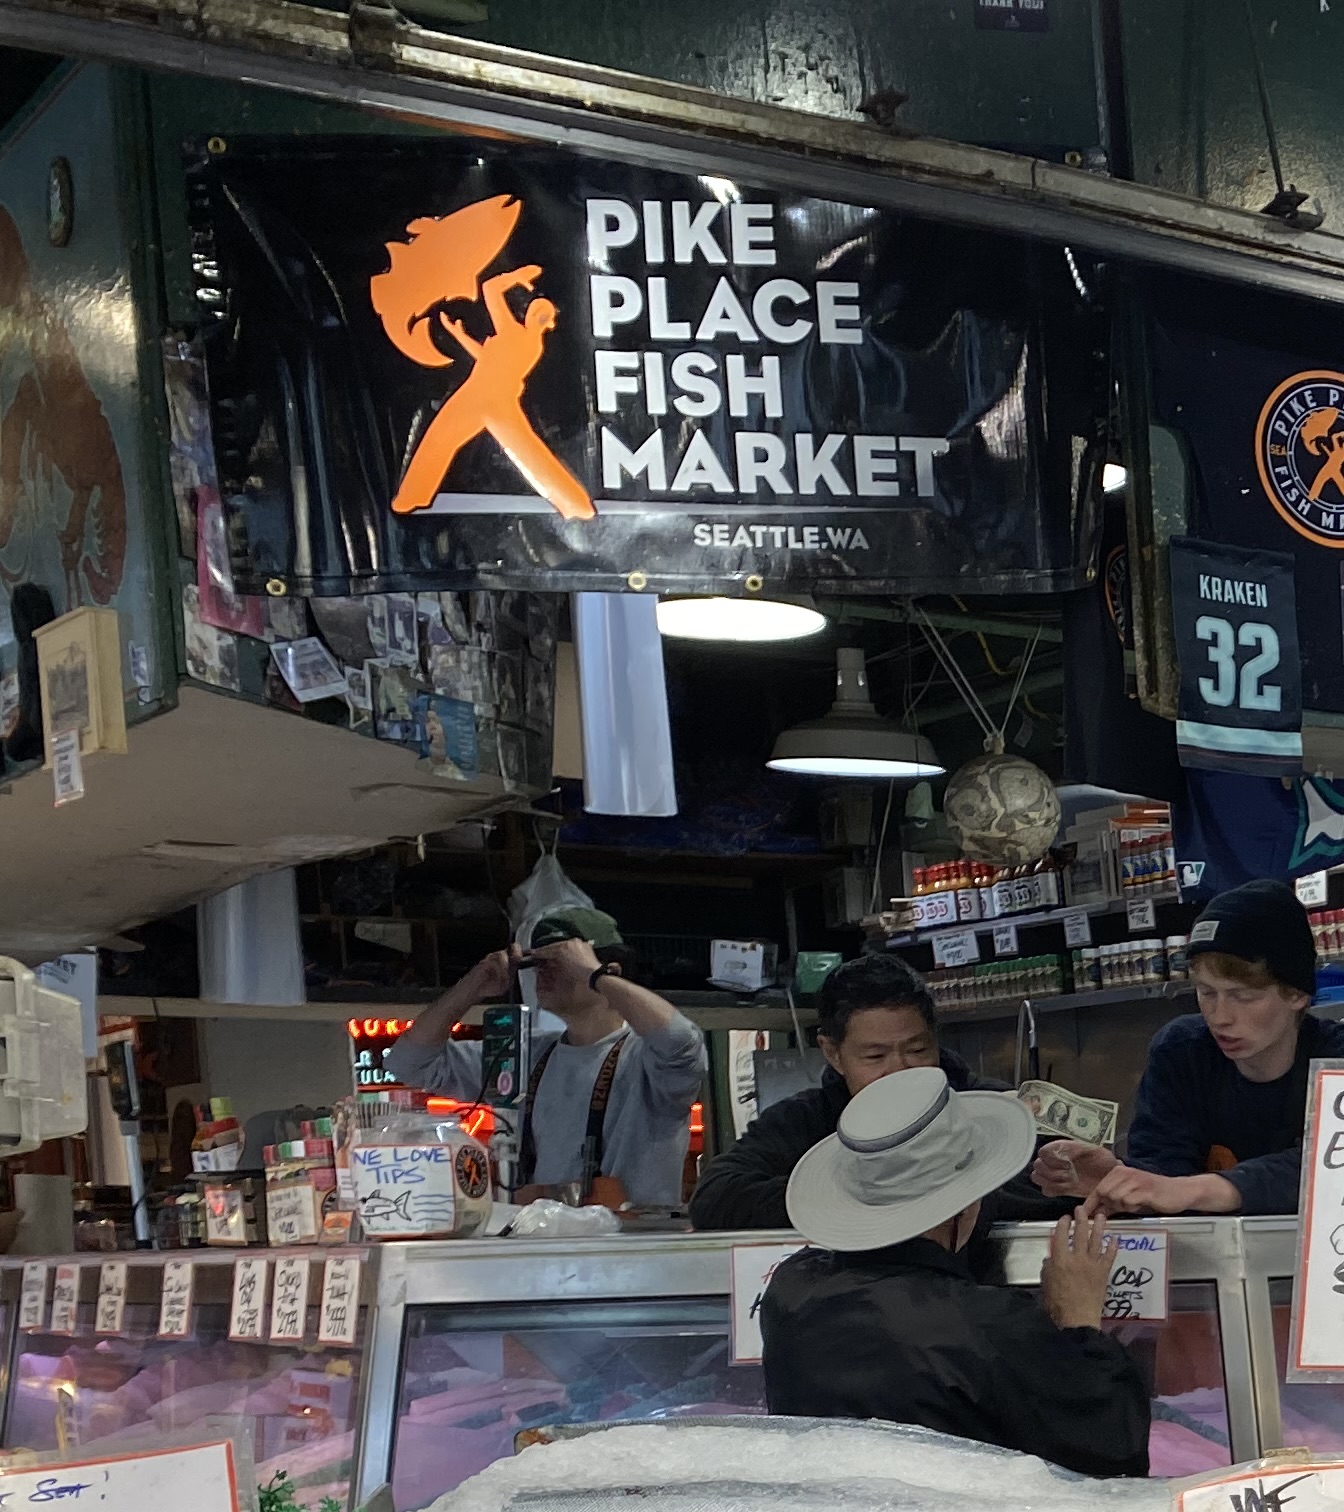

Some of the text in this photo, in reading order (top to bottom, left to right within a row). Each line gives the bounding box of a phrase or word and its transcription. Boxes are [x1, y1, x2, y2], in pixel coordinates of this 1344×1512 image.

[586, 198, 776, 266] PIKE
[589, 275, 863, 345] PLACE
[595, 350, 784, 417] FISH
[1273, 390, 1317, 437] PIKE
[601, 427, 950, 497] MARKET
[1274, 466, 1310, 516] FISH
[1199, 574, 1268, 608] KRAKEN
[1195, 615, 1282, 712] 32
[366, 1164, 425, 1184] TIPS
[394, 1148, 450, 1162] LOVE
[1112, 1266, 1154, 1288] COD
